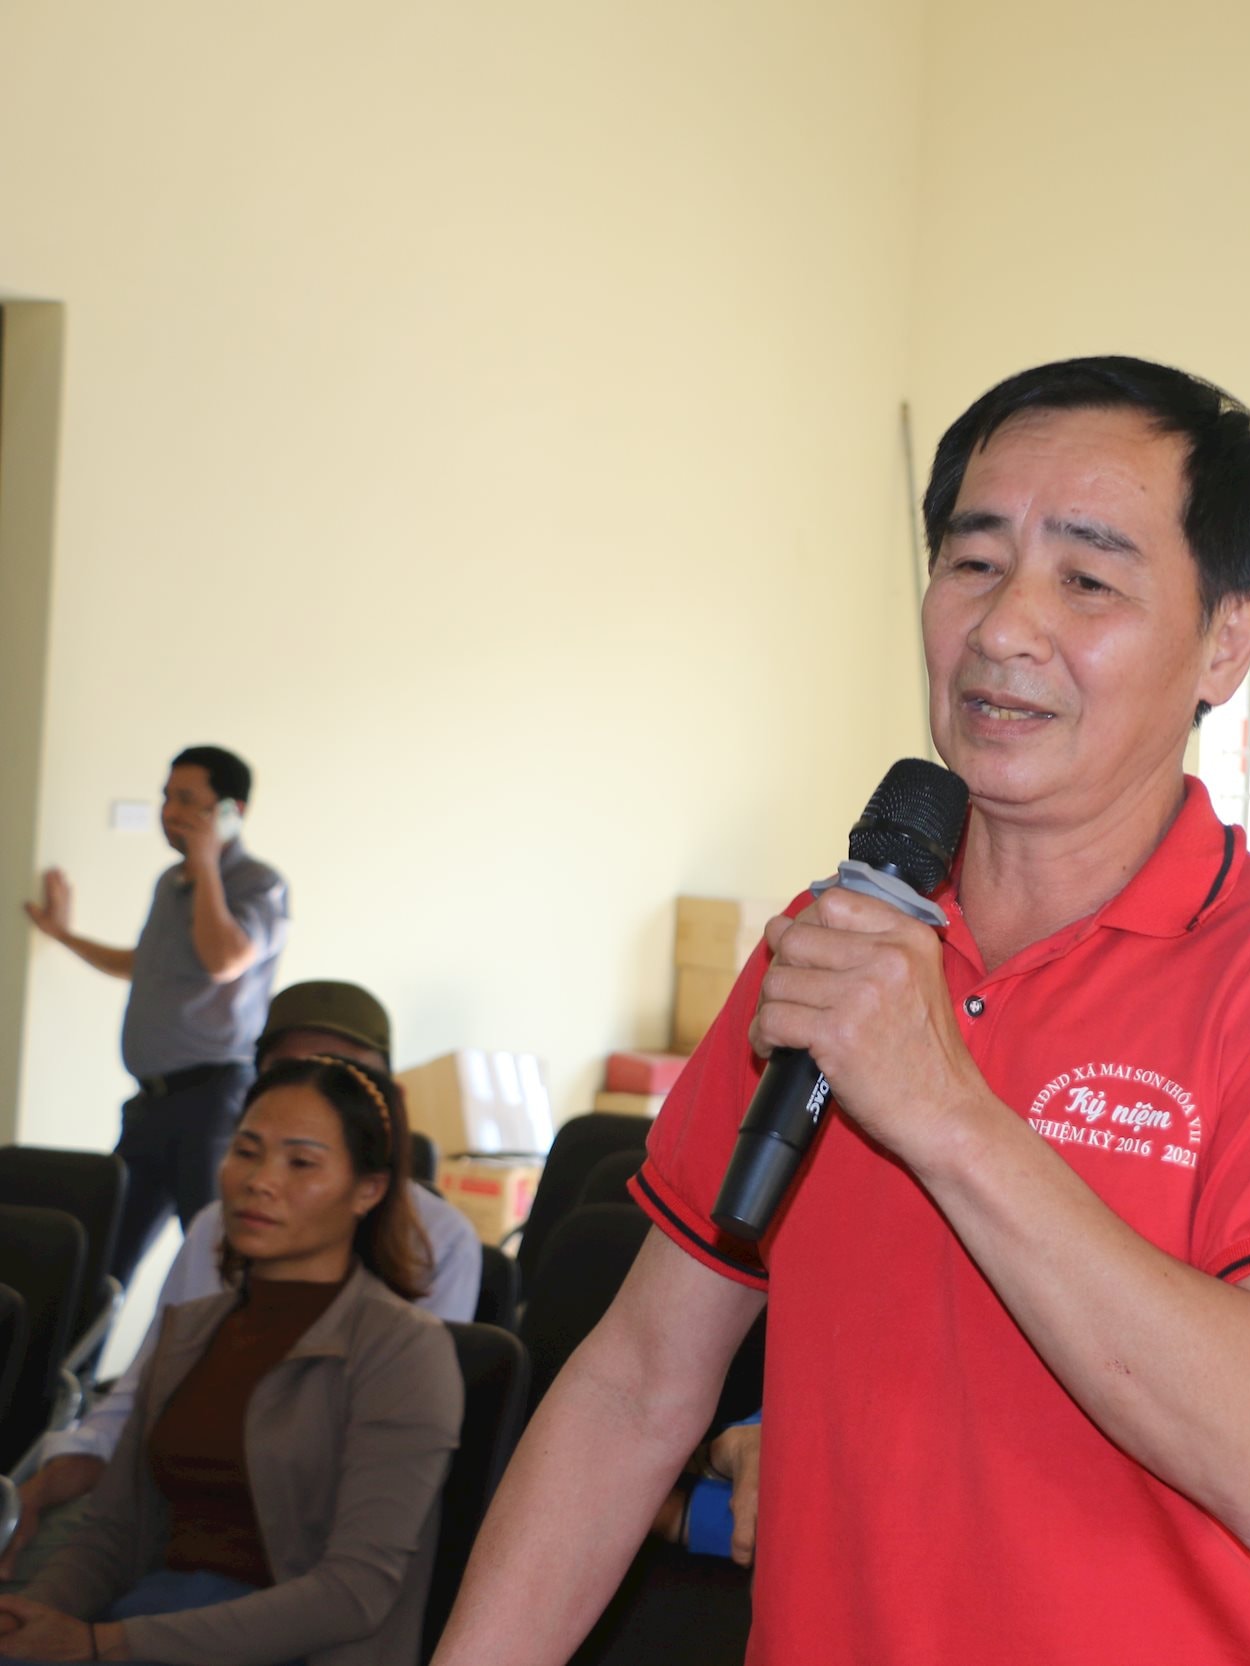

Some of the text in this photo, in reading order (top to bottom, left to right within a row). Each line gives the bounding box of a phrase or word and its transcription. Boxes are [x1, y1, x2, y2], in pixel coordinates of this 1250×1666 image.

[1030, 1063, 1201, 1143] HĐND XÃ MAI SƠN KHÓA VII
[1064, 1085, 1172, 1133] Kỷ niệm
[1027, 1117, 1198, 1168] NHIỆM KỲ 2016 2021
